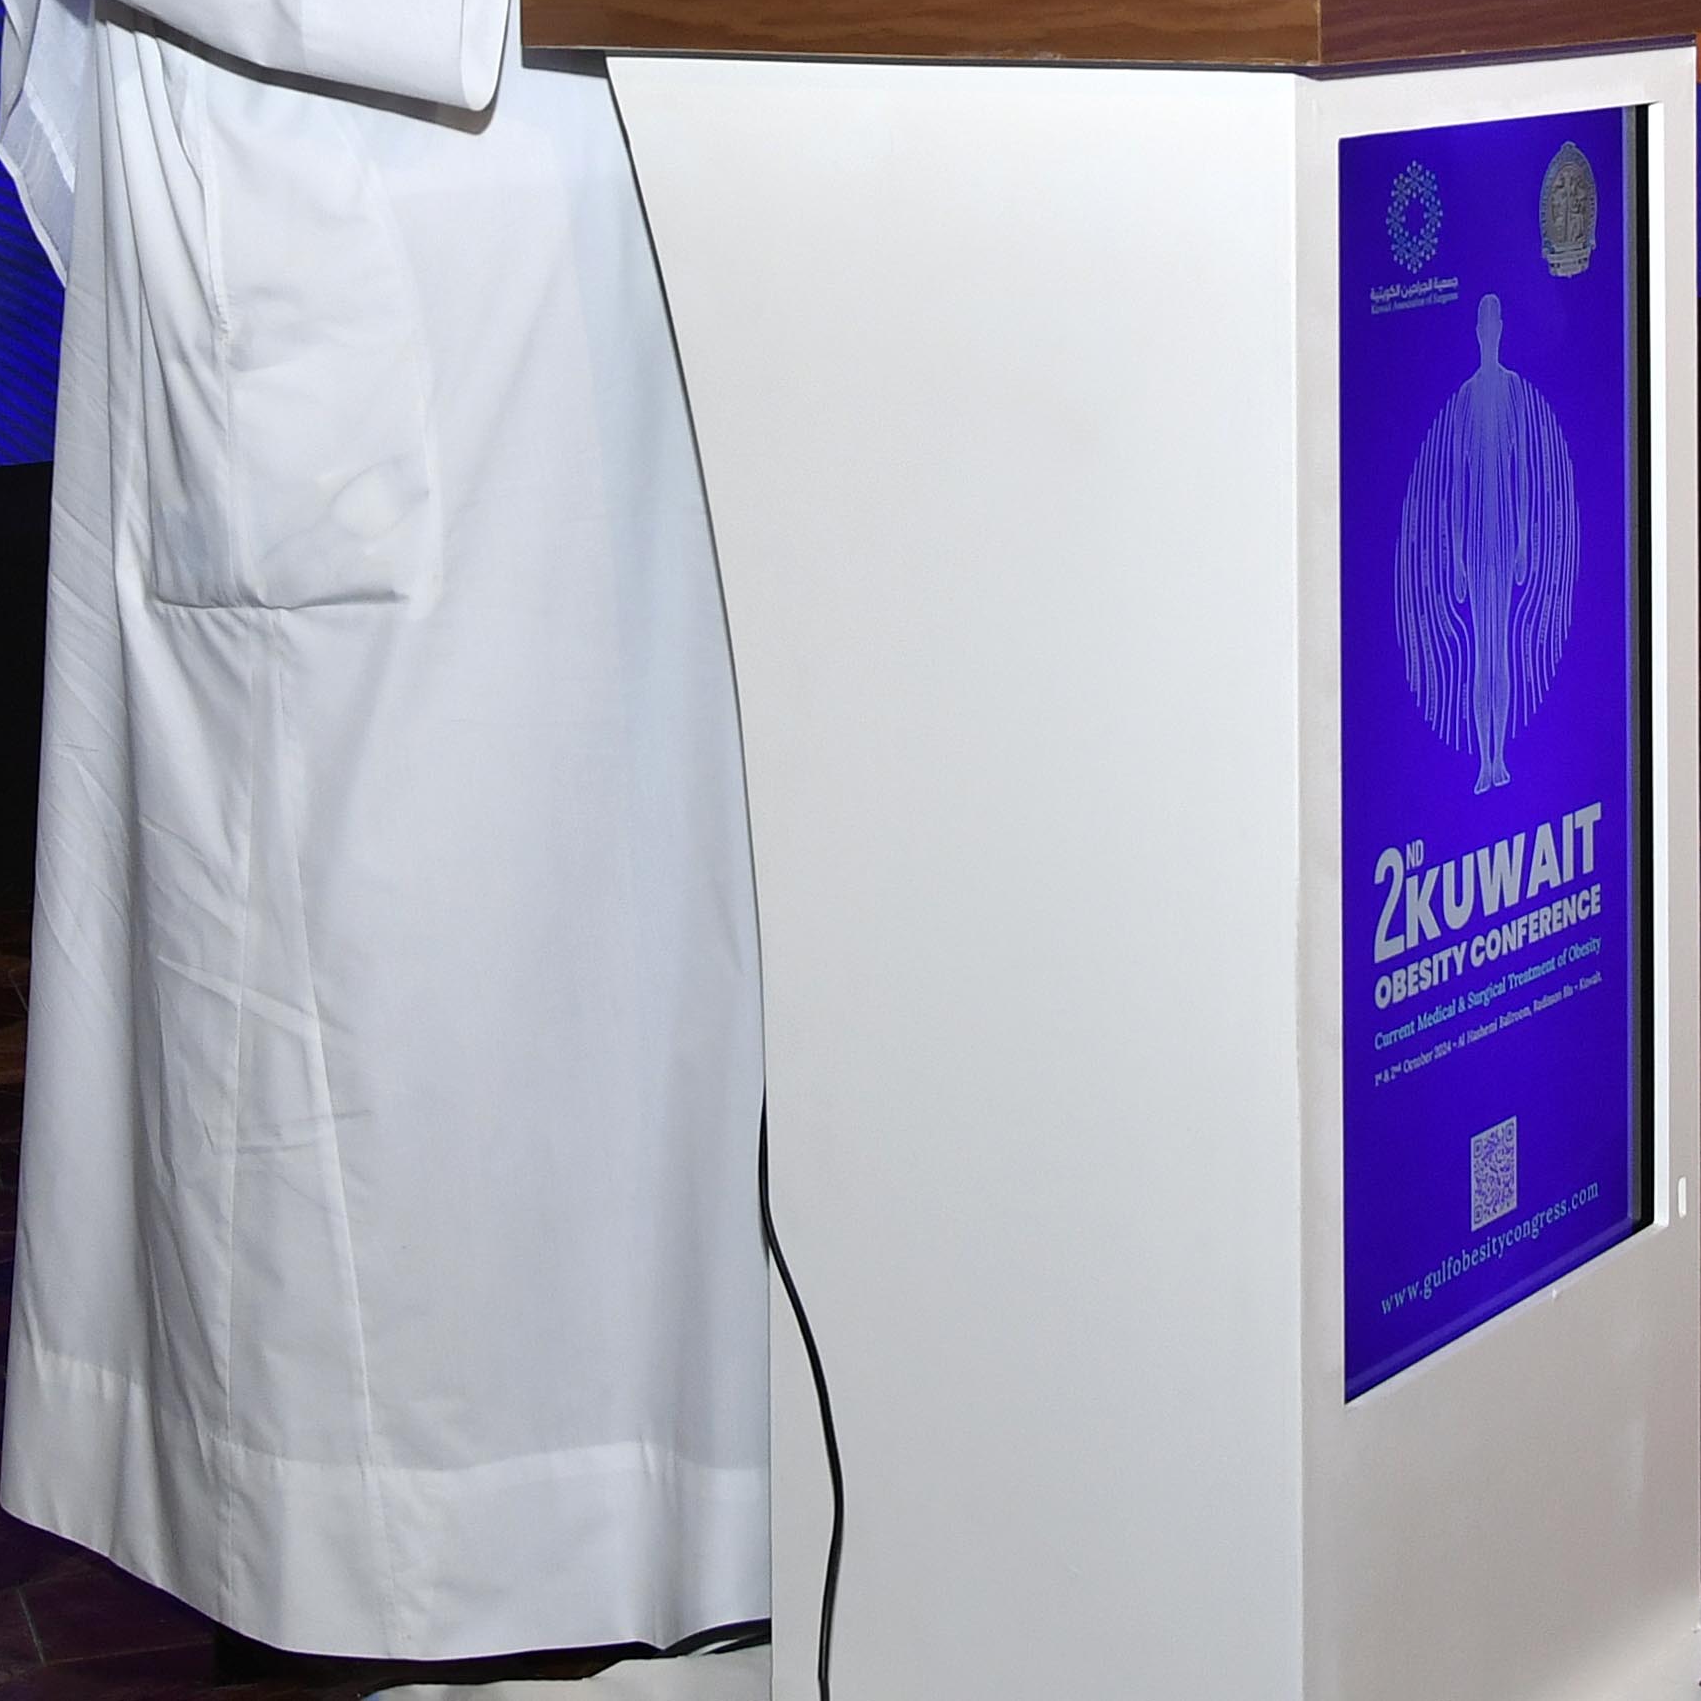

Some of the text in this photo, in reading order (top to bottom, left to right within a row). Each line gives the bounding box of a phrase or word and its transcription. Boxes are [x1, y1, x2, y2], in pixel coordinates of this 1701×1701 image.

[1405, 801, 1602, 950] KUWAIT
[1374, 883, 1601, 1010] OBESITY CONFERENCE
[1374, 936, 1602, 1050] Current Medical & Surgical Treatment of Obesity
[1380, 1181, 1599, 1315] www.gulfobesitycongress.com
